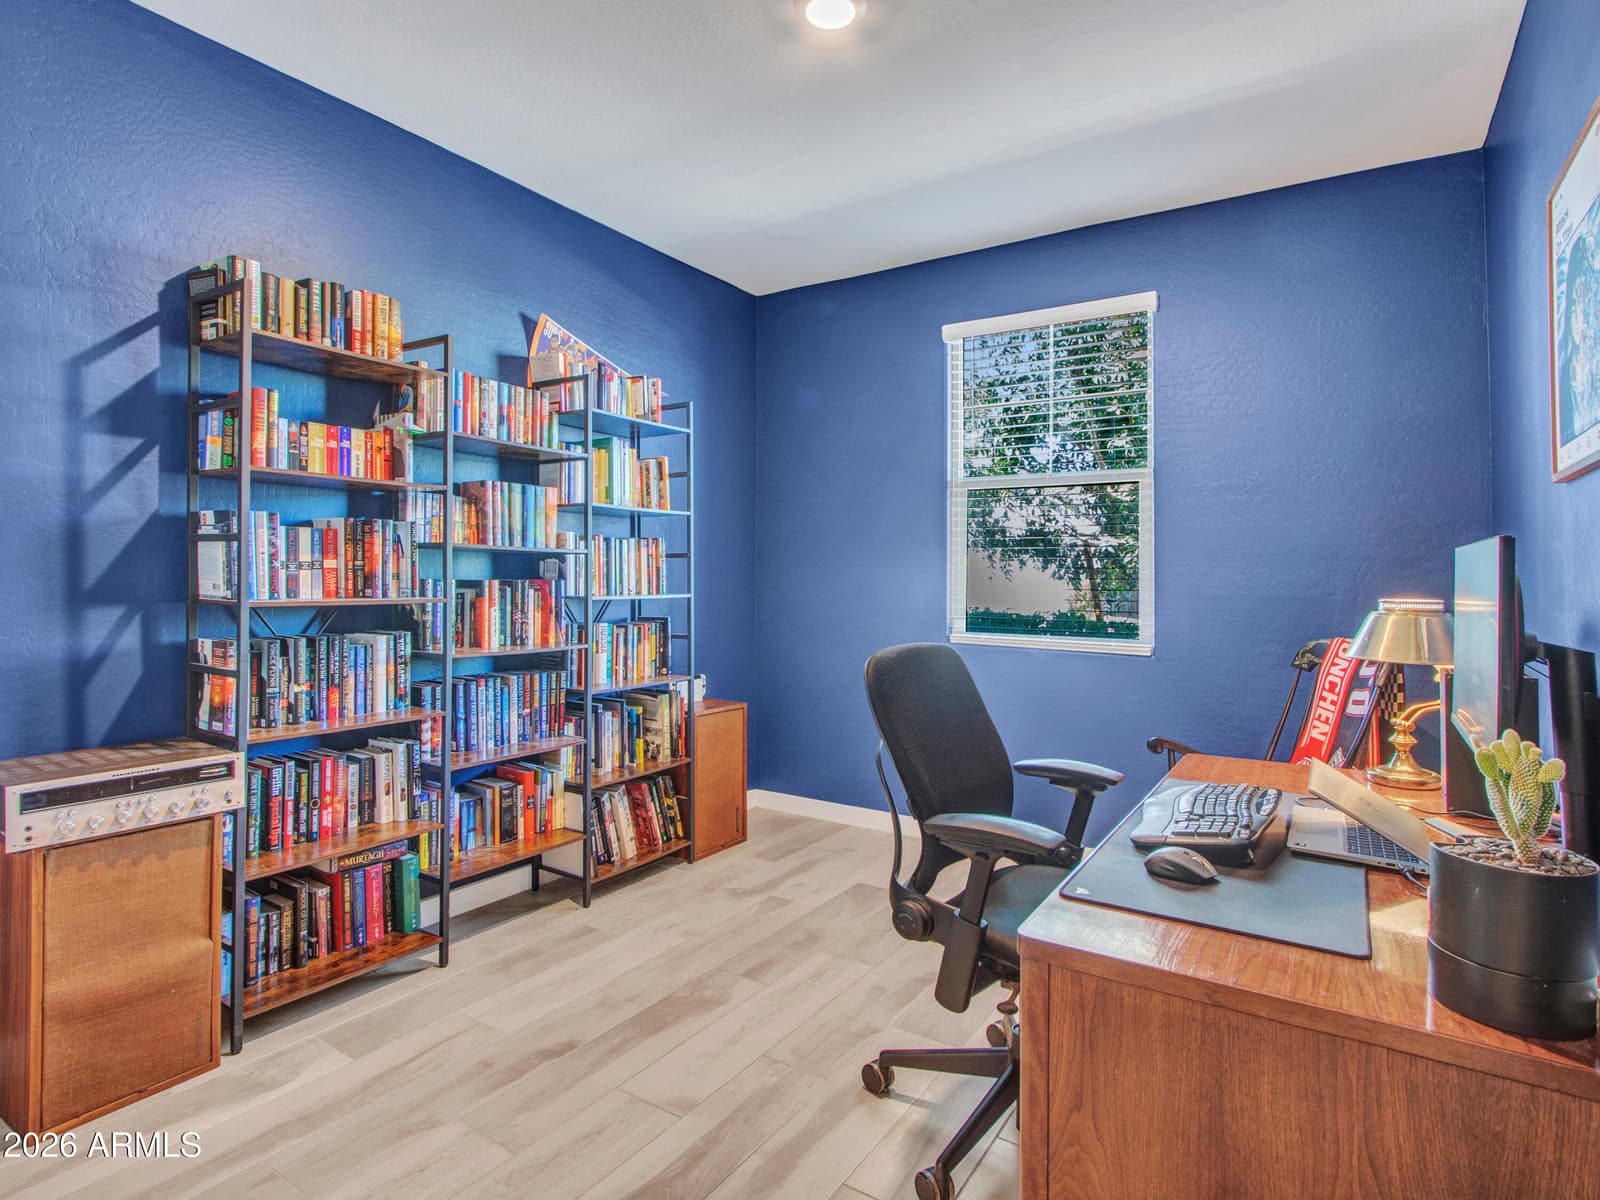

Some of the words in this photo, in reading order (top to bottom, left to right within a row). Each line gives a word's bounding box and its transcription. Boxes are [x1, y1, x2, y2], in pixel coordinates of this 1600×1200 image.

[272, 768, 282, 796] Griffin
[269, 796, 281, 827] Special
[268, 828, 280, 845] Ops
[344, 849, 385, 867] MURTAGH
